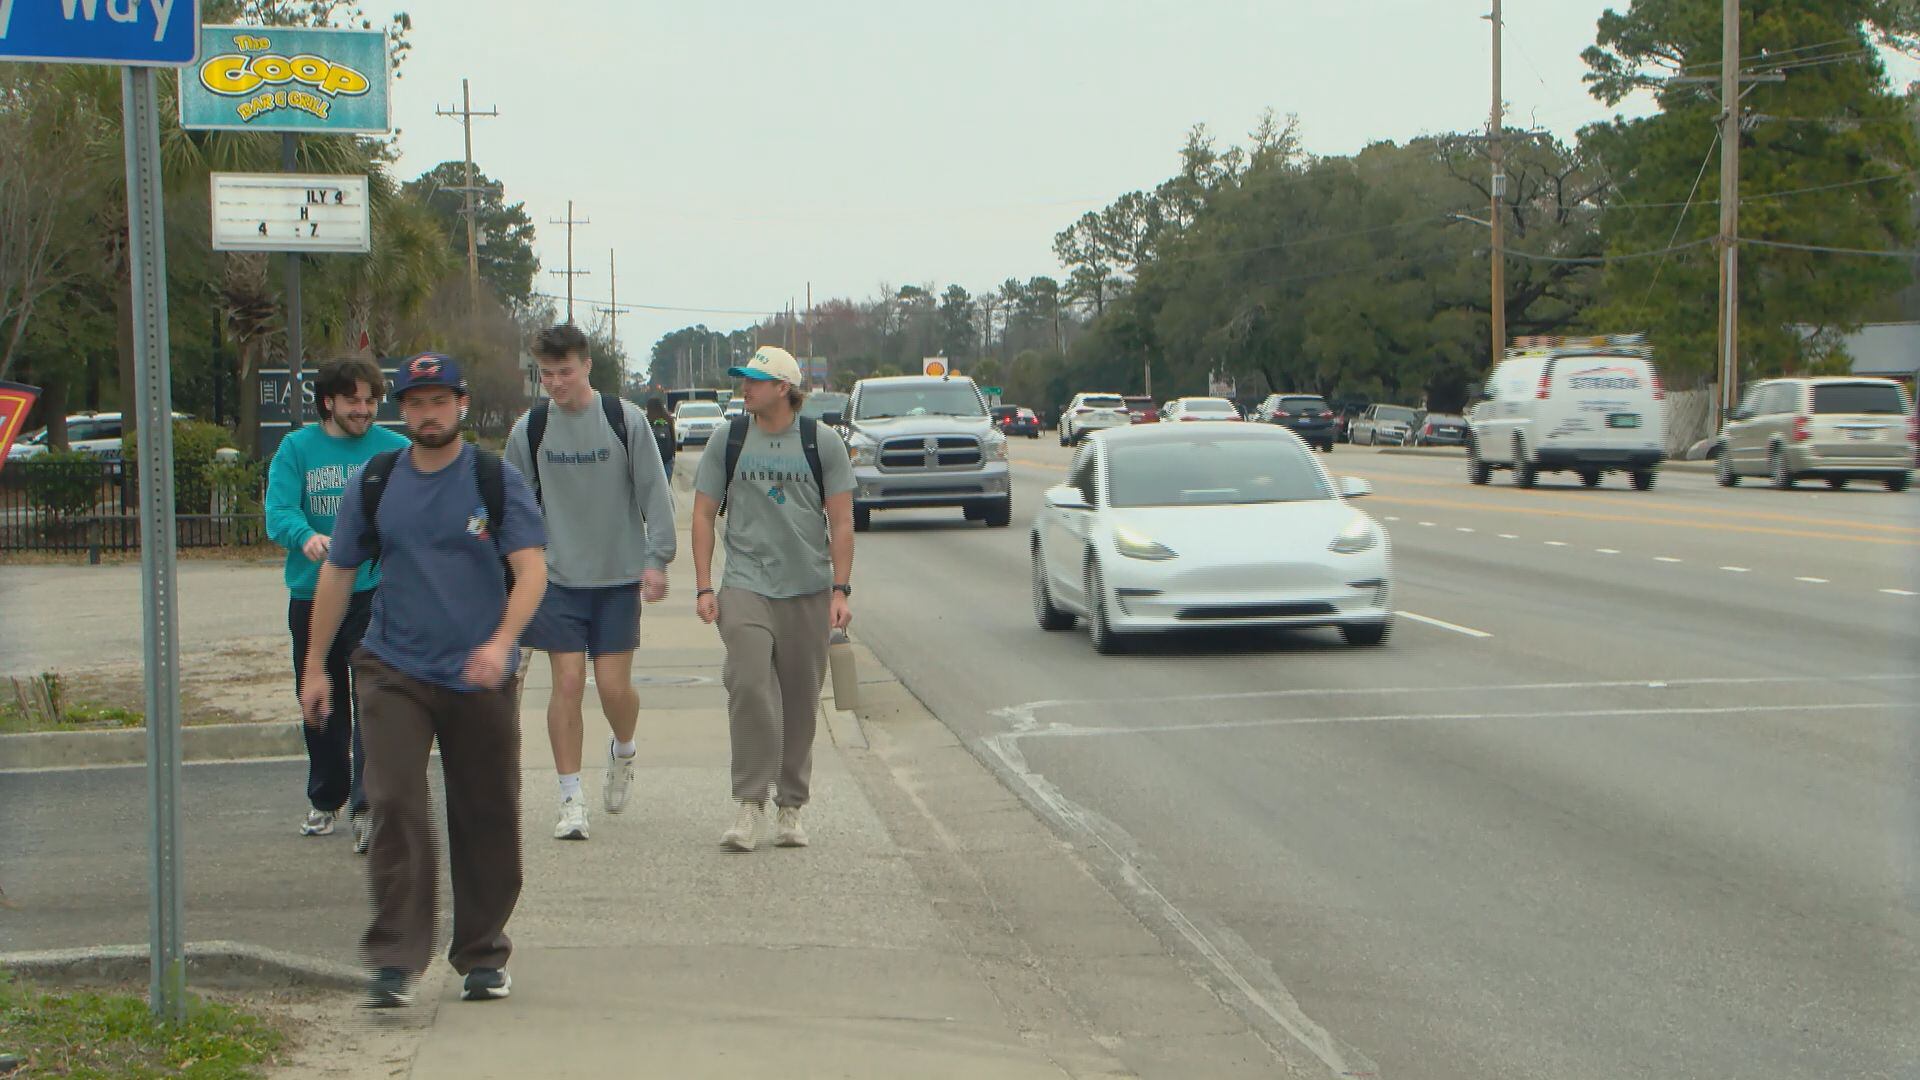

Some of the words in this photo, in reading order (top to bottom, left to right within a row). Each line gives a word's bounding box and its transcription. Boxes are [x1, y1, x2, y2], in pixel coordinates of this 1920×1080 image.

[234, 35, 271, 51] The
[237, 93, 273, 122] BAR
[288, 91, 331, 118] GRILL
[334, 191, 343, 204] 4
[300, 206, 309, 220] H
[258, 222, 268, 235] 4
[310, 223, 319, 237] 7
[1568, 377, 1642, 390] STRADA
[264, 380, 274, 403] THE
[545, 450, 597, 464] Timberland
[741, 471, 809, 483] BASEBALL
